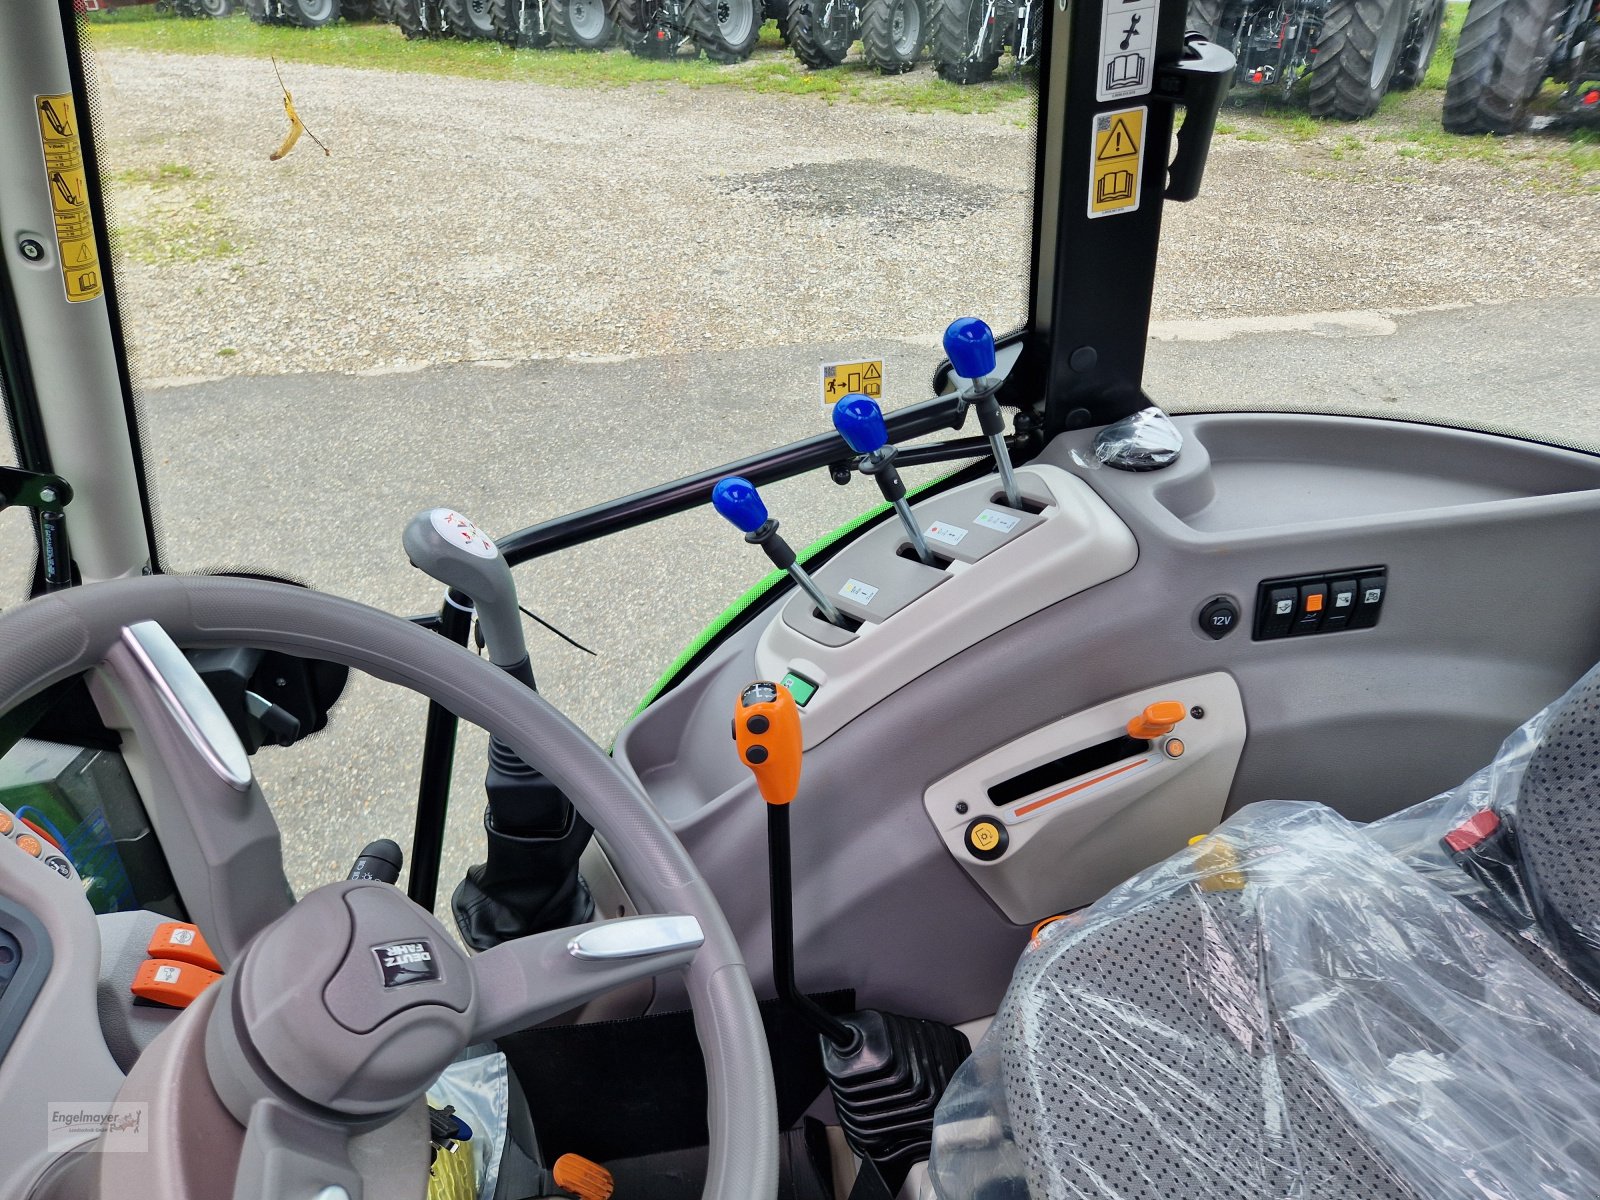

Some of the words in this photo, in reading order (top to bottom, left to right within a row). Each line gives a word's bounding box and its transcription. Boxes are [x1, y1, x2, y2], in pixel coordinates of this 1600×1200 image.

[1212, 615, 1232, 625] 12V
[387, 943, 424, 956] FAHR
[383, 951, 431, 967] DEUTZ
